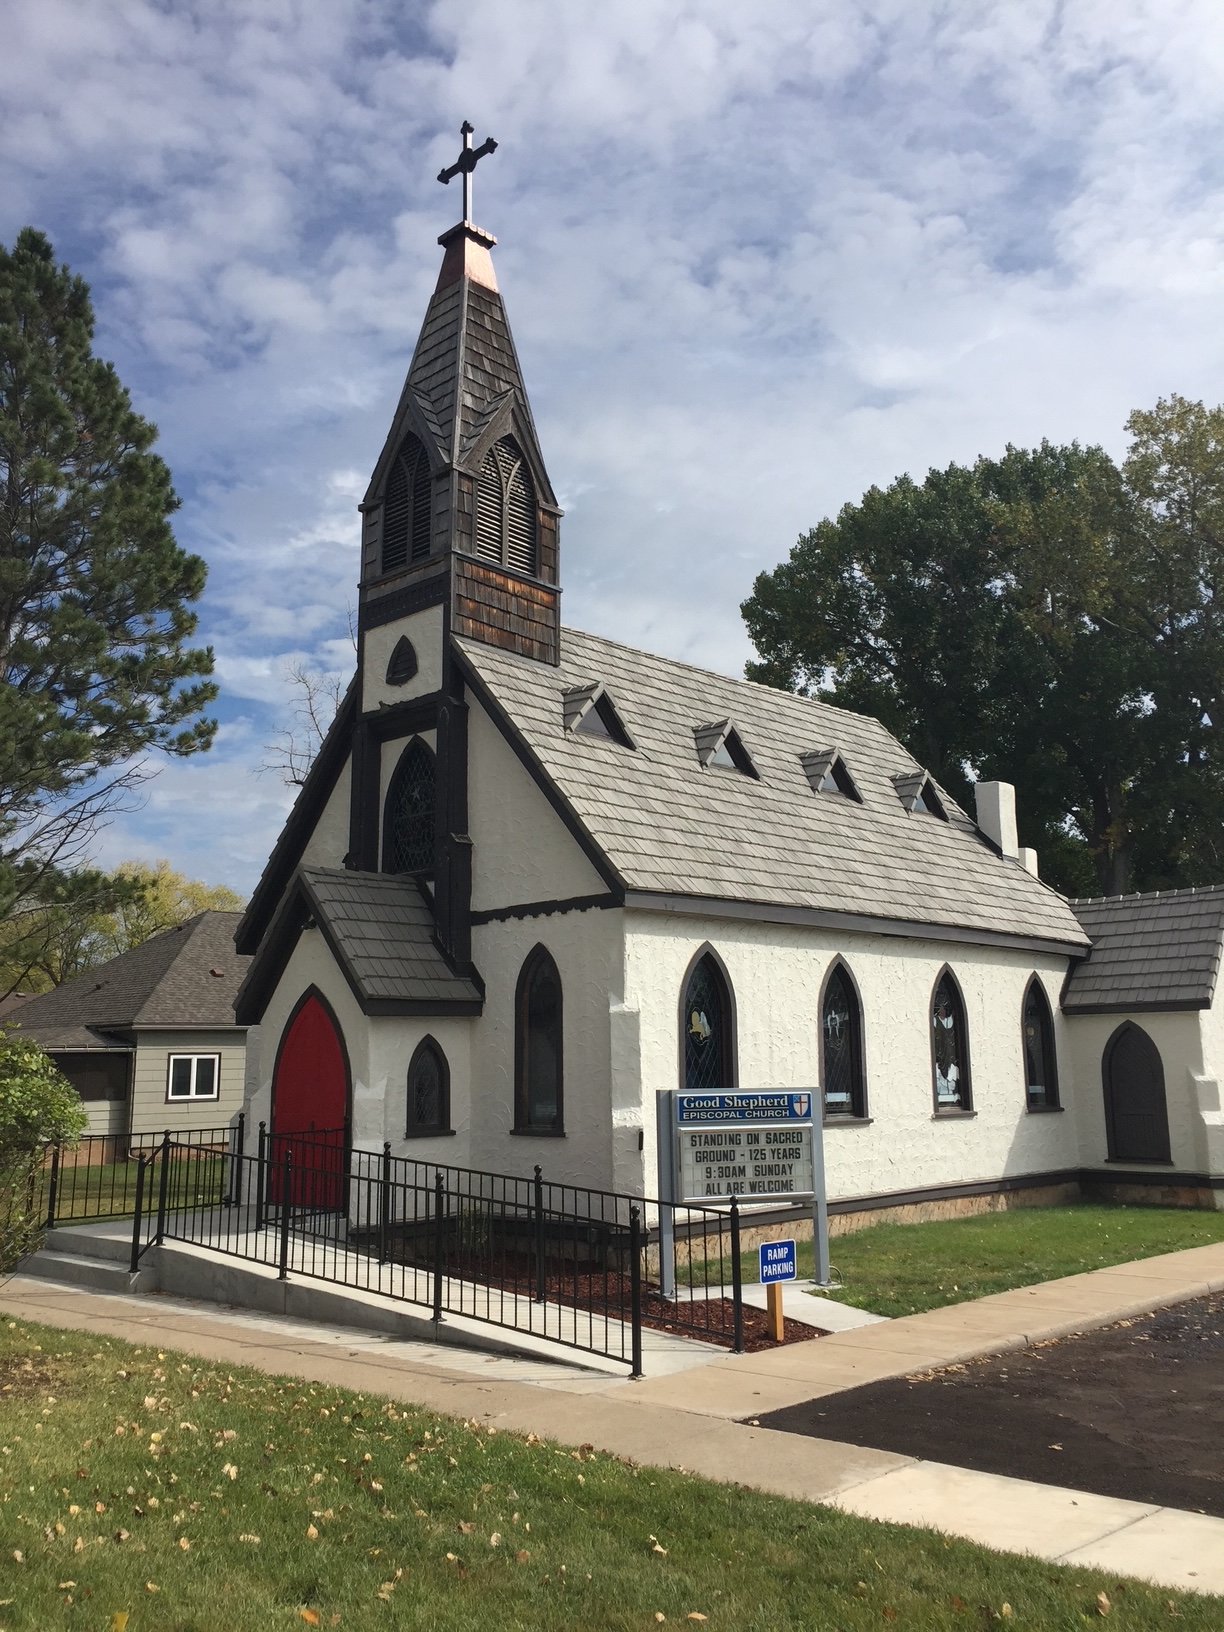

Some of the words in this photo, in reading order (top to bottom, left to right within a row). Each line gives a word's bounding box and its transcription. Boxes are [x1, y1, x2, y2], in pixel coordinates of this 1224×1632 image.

[683, 1097, 720, 1108] Good
[724, 1096, 788, 1109] Shepherd
[683, 1111, 742, 1119] EPISCOPAL
[691, 1134, 741, 1146] STANDING
[747, 1133, 759, 1144] ON
[766, 1132, 802, 1144] SACRED
[696, 1150, 735, 1162] GROUND
[750, 1149, 766, 1160] 125
[771, 1148, 800, 1160] YEARS
[706, 1166, 746, 1178] 9:30AM
[754, 1164, 793, 1177] SUNDAY
[706, 1183, 722, 1195] ALL
[727, 1182, 744, 1194] ARE
[750, 1180, 793, 1192] WELCOME
[768, 1247, 788, 1260] RAMP
[763, 1261, 793, 1277] PARKING
